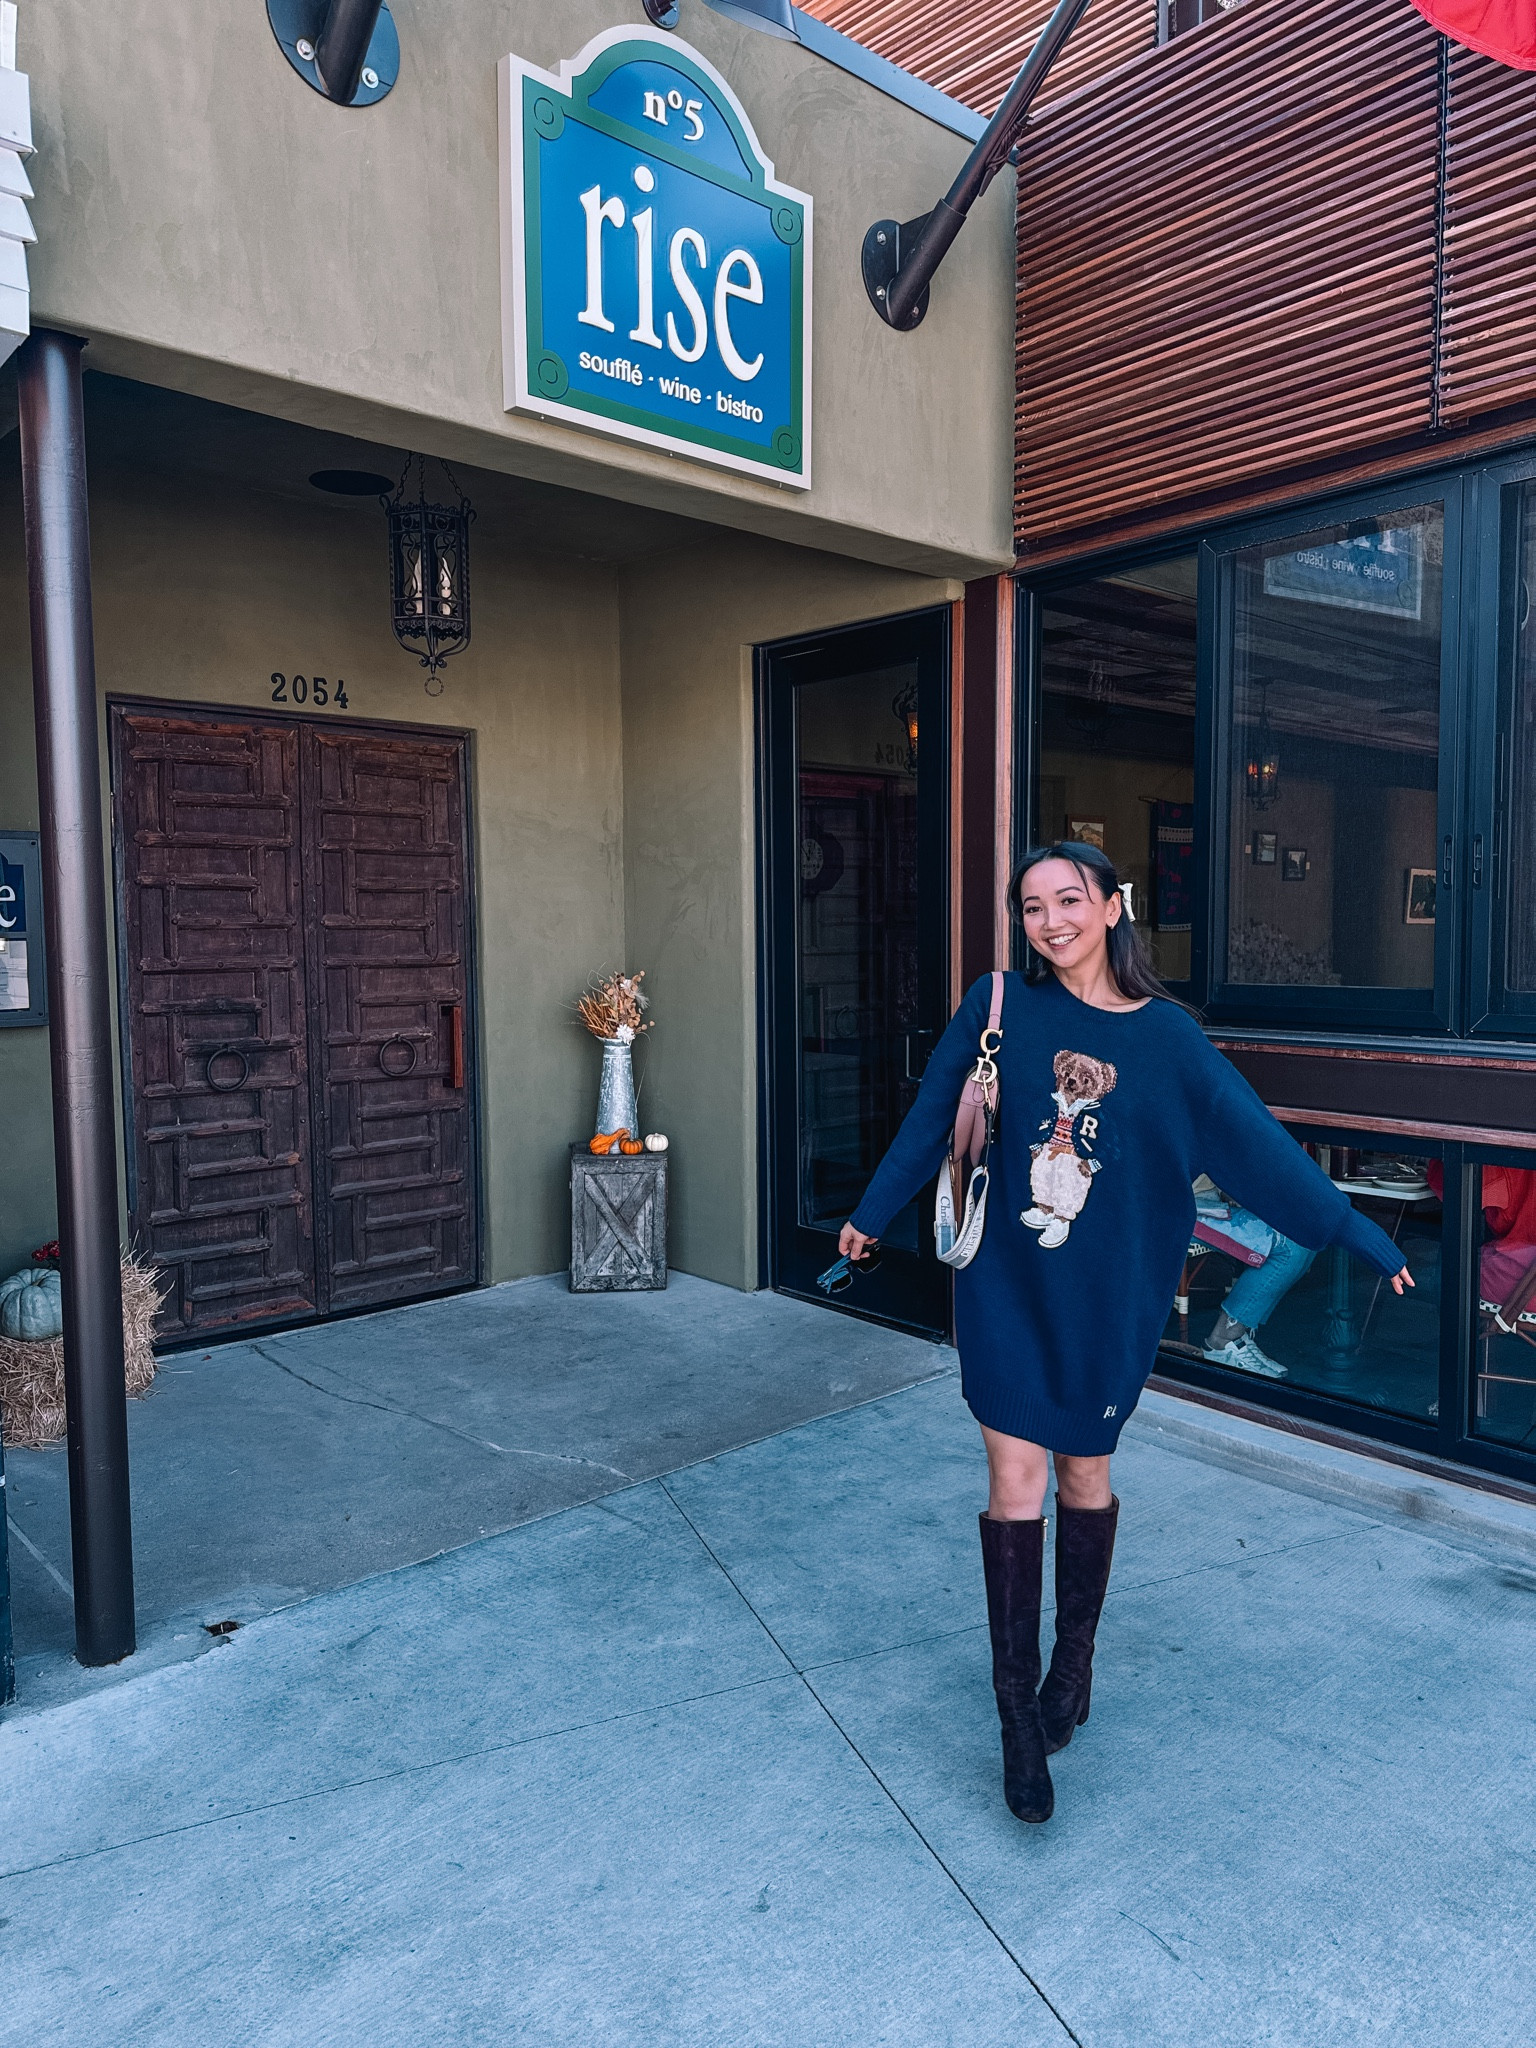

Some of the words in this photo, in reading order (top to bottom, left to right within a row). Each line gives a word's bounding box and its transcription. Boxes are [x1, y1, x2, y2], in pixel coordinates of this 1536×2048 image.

[578, 165, 764, 381] rise
[579, 350, 643, 386] soufflé
[659, 376, 701, 404] wine
[716, 390, 764, 424] bistro
[270, 672, 349, 709] 2054
[1079, 1115, 1099, 1140] R
